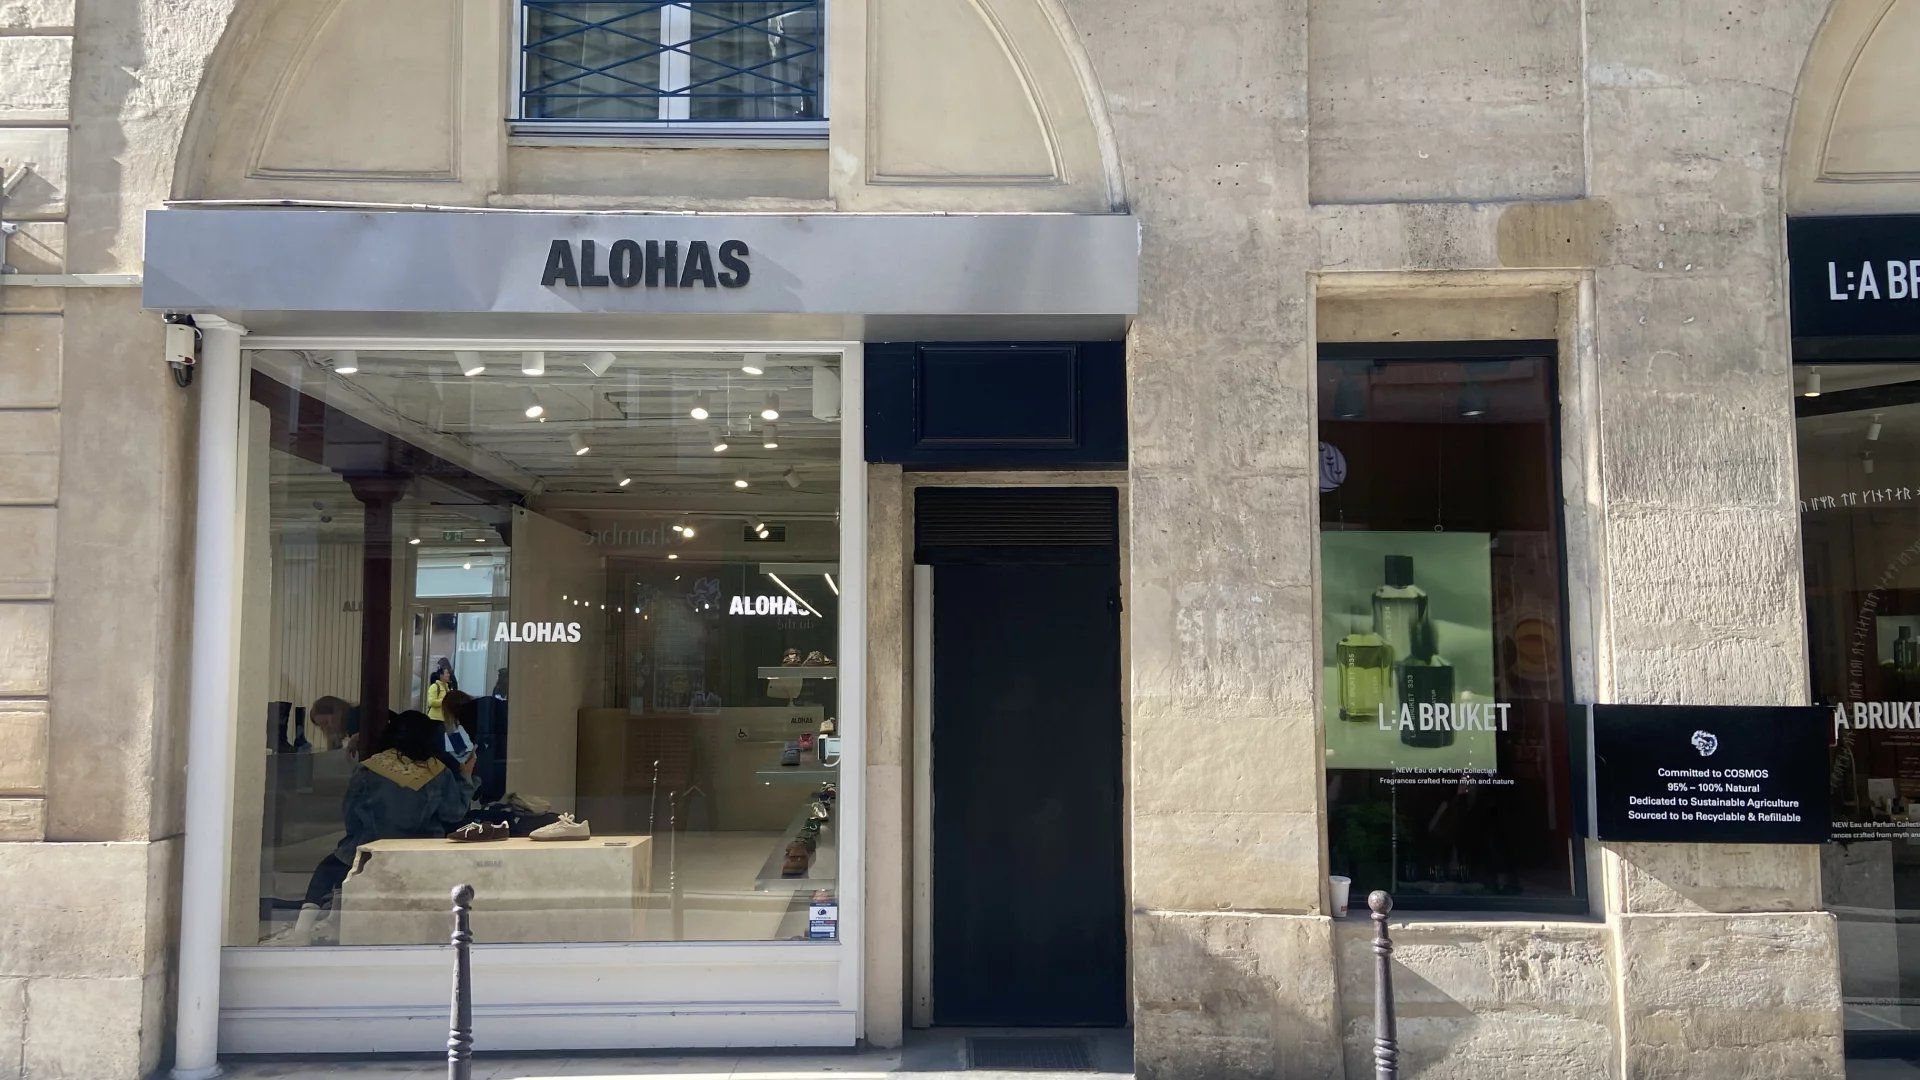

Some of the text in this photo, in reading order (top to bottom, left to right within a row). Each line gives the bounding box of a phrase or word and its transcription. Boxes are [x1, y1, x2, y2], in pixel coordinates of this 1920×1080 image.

[541, 239, 750, 288] ALOHAS
[1828, 261, 1881, 300] L:A
[494, 621, 581, 642] ALOHAS
[1378, 703, 1415, 731] L:A
[1419, 703, 1511, 731] BRUKET
[1658, 768, 1769, 778] Committed to COSMOS
[1379, 777, 1416, 786] Fragrances
[1417, 777, 1440, 785] crafted
[1442, 777, 1458, 785] from
[1459, 777, 1477, 786] myth
[1667, 783, 1688, 792] 95%
[1698, 783, 1723, 792] 100%
[1725, 783, 1760, 793] Natural
[1629, 796, 1799, 809] Dedicated to Sustainable Agriculture
[1628, 810, 1801, 823] Sourced to be Recyclable & Refillable
[1853, 831, 1875, 839] crafted
[1893, 831, 1910, 840] myth
